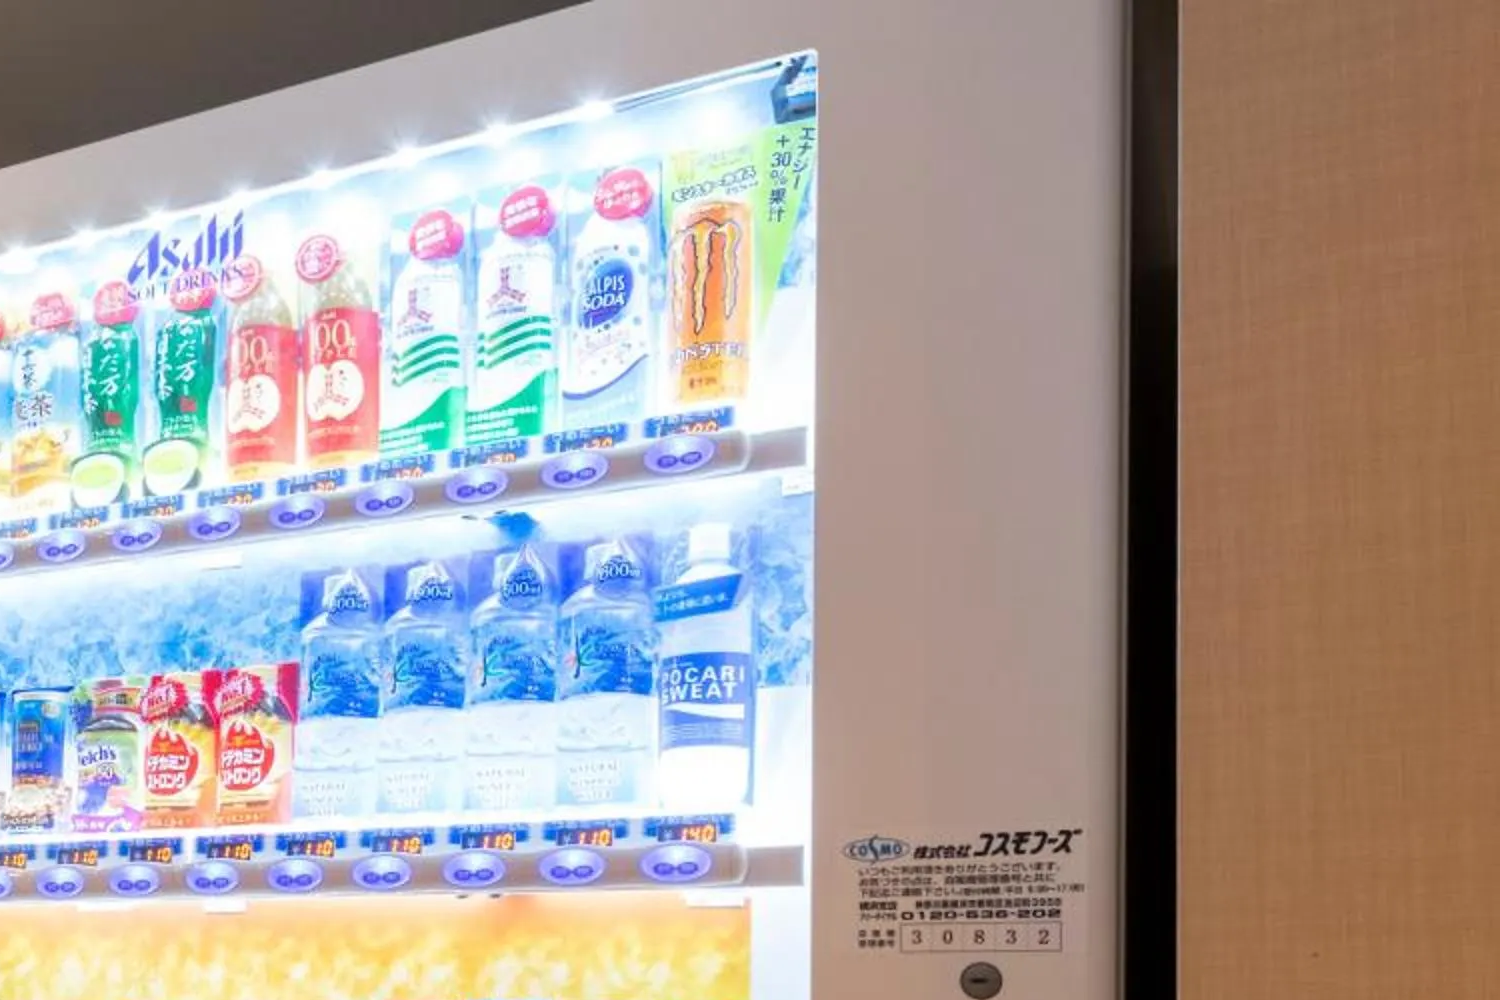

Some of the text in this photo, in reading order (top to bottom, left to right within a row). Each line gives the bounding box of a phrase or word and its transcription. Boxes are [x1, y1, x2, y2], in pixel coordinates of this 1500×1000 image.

[127, 208, 244, 285] Asahi
[849, 836, 903, 862] COSMO
[972, 829, 1083, 857] コスモフーズ
